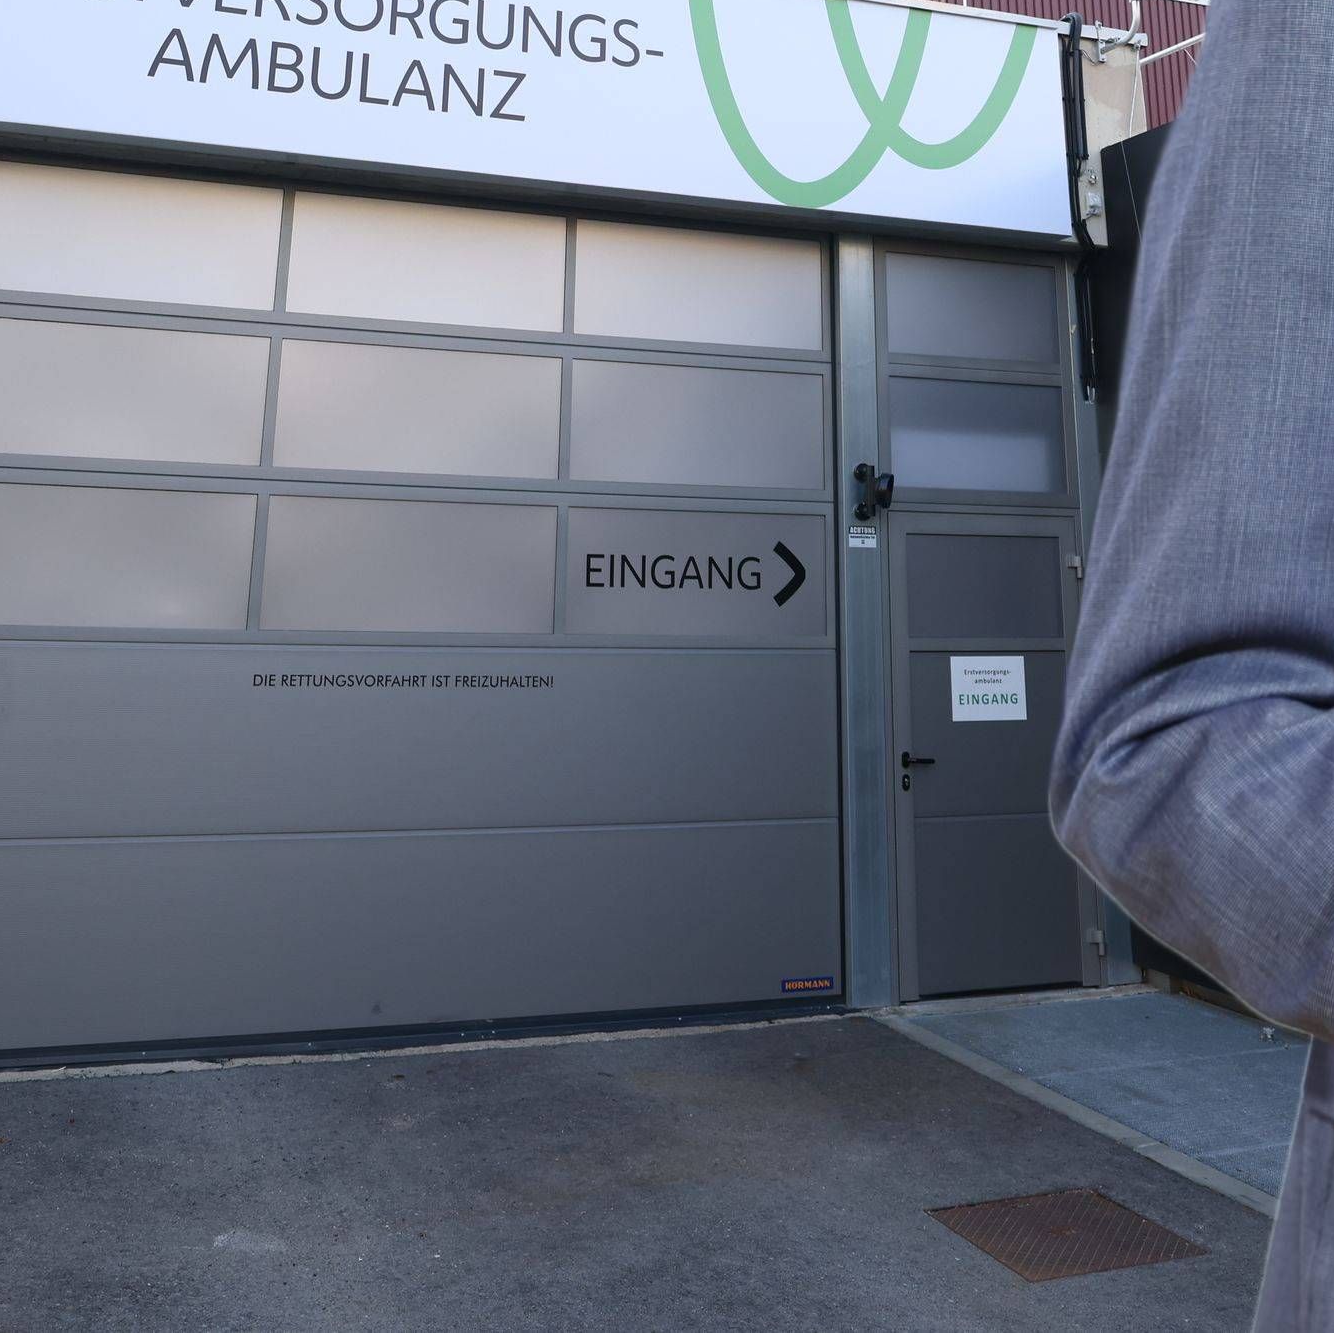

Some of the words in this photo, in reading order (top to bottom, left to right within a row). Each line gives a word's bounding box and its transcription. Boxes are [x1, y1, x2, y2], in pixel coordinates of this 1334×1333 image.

[147, 28, 527, 122] AMBULANZ
[585, 553, 761, 591] EINGANG
[252, 674, 277, 687] DIE
[281, 674, 428, 688] RETTUNGSVORFAHRT
[431, 675, 451, 688] IST
[455, 675, 555, 688] FREIZUHALTEN!
[958, 693, 1019, 706] EINGANG
